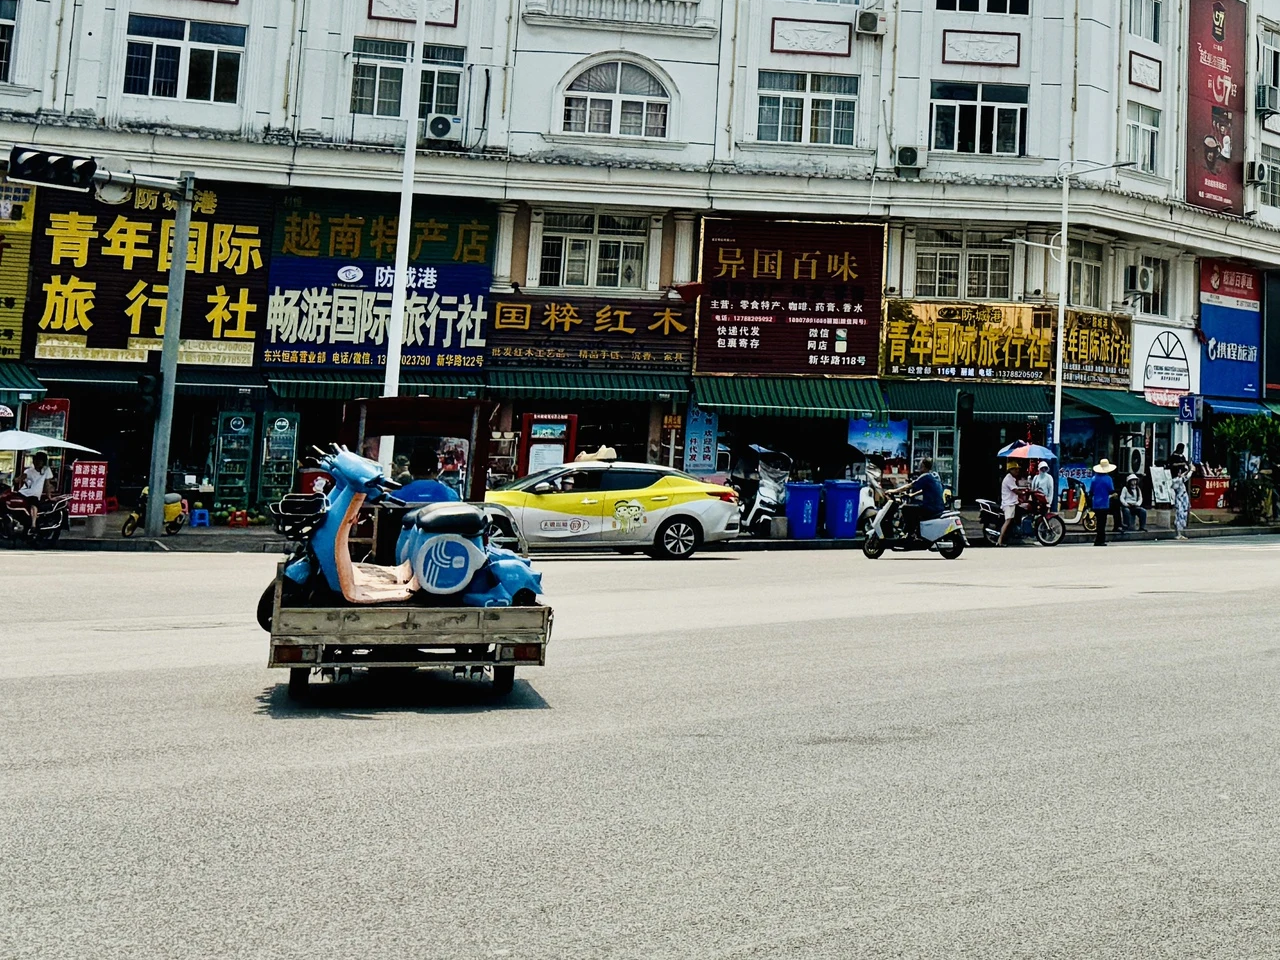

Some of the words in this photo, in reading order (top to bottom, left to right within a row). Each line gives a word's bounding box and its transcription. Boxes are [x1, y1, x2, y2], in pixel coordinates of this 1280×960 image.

[45, 211, 263, 275] 青年国际
[281, 211, 490, 264] 越南特产店
[713, 247, 859, 282] 异国百味
[38, 275, 257, 338] 旅行社
[494, 302, 687, 336] 国粹红木
[716, 325, 761, 337] 快递代发
[716, 337, 760, 349] 包裹寄存
[808, 328, 830, 339] 微信
[888, 320, 1051, 368] 青年国际旅行社
[807, 340, 828, 351] 网店
[1217, 341, 1258, 363] 携程旅游
[808, 355, 866, 367] 新华路118号
